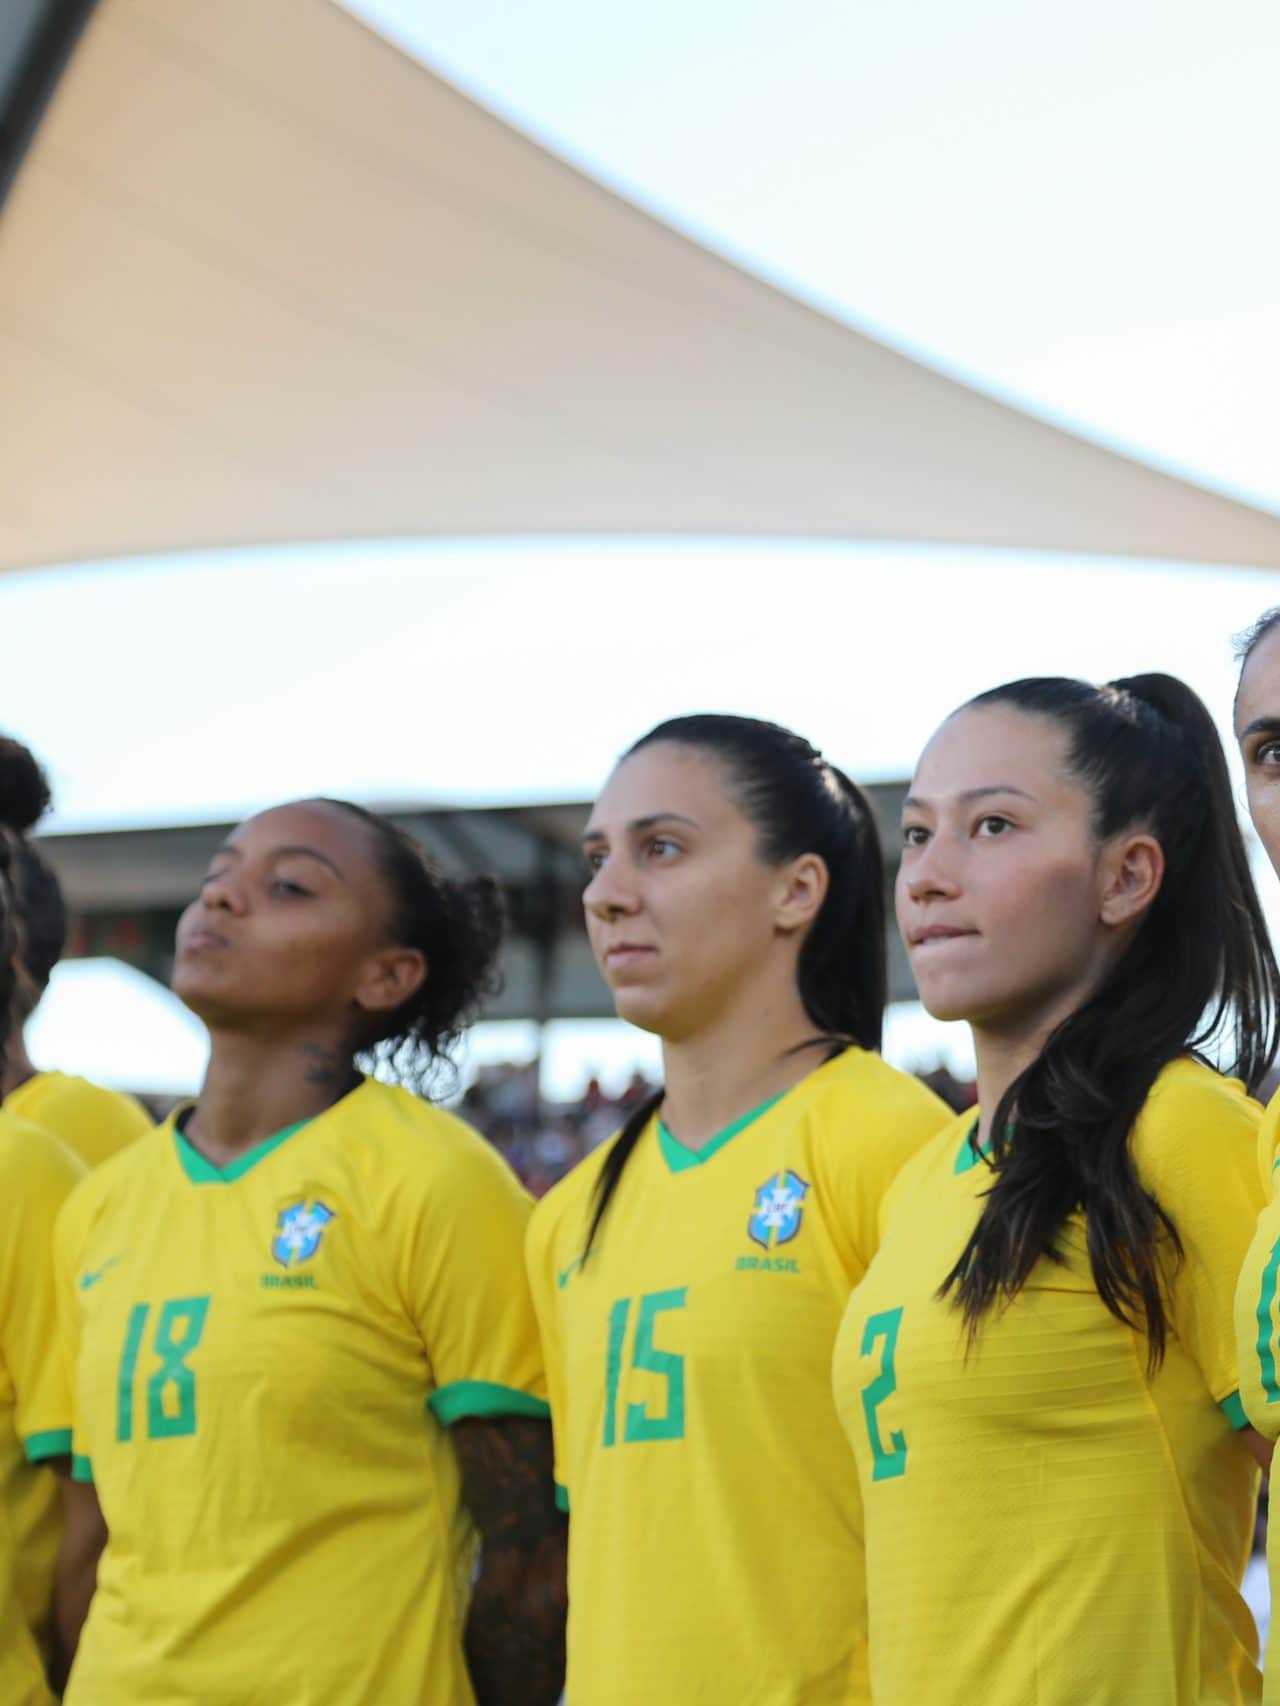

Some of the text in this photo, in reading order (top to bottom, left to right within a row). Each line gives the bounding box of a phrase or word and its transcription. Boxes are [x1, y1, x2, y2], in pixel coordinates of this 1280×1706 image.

[736, 1257, 800, 1273] BRASIL
[117, 1296, 211, 1443] 18
[603, 1286, 688, 1447] 15
[861, 1306, 907, 1481] 2
